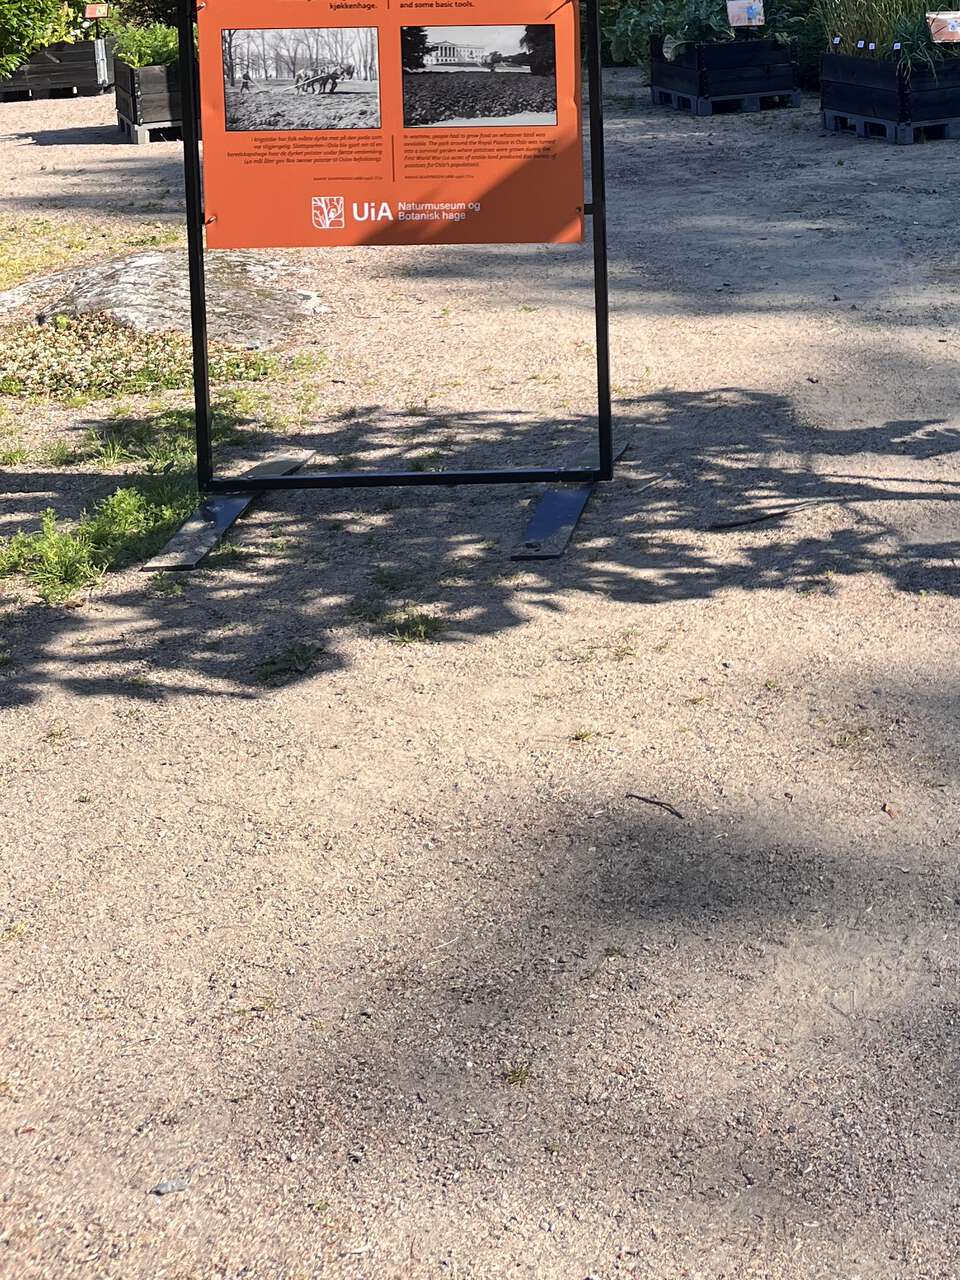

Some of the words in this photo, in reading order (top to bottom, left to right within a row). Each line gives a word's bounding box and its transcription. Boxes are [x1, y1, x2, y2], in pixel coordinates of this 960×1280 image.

[400, 0, 413, 8] and
[353, 202, 394, 221] UiA
[398, 201, 466, 211] Naturmuseum
[468, 203, 480, 212] og
[398, 211, 440, 221] Botanisk
[442, 211, 466, 222] hage
